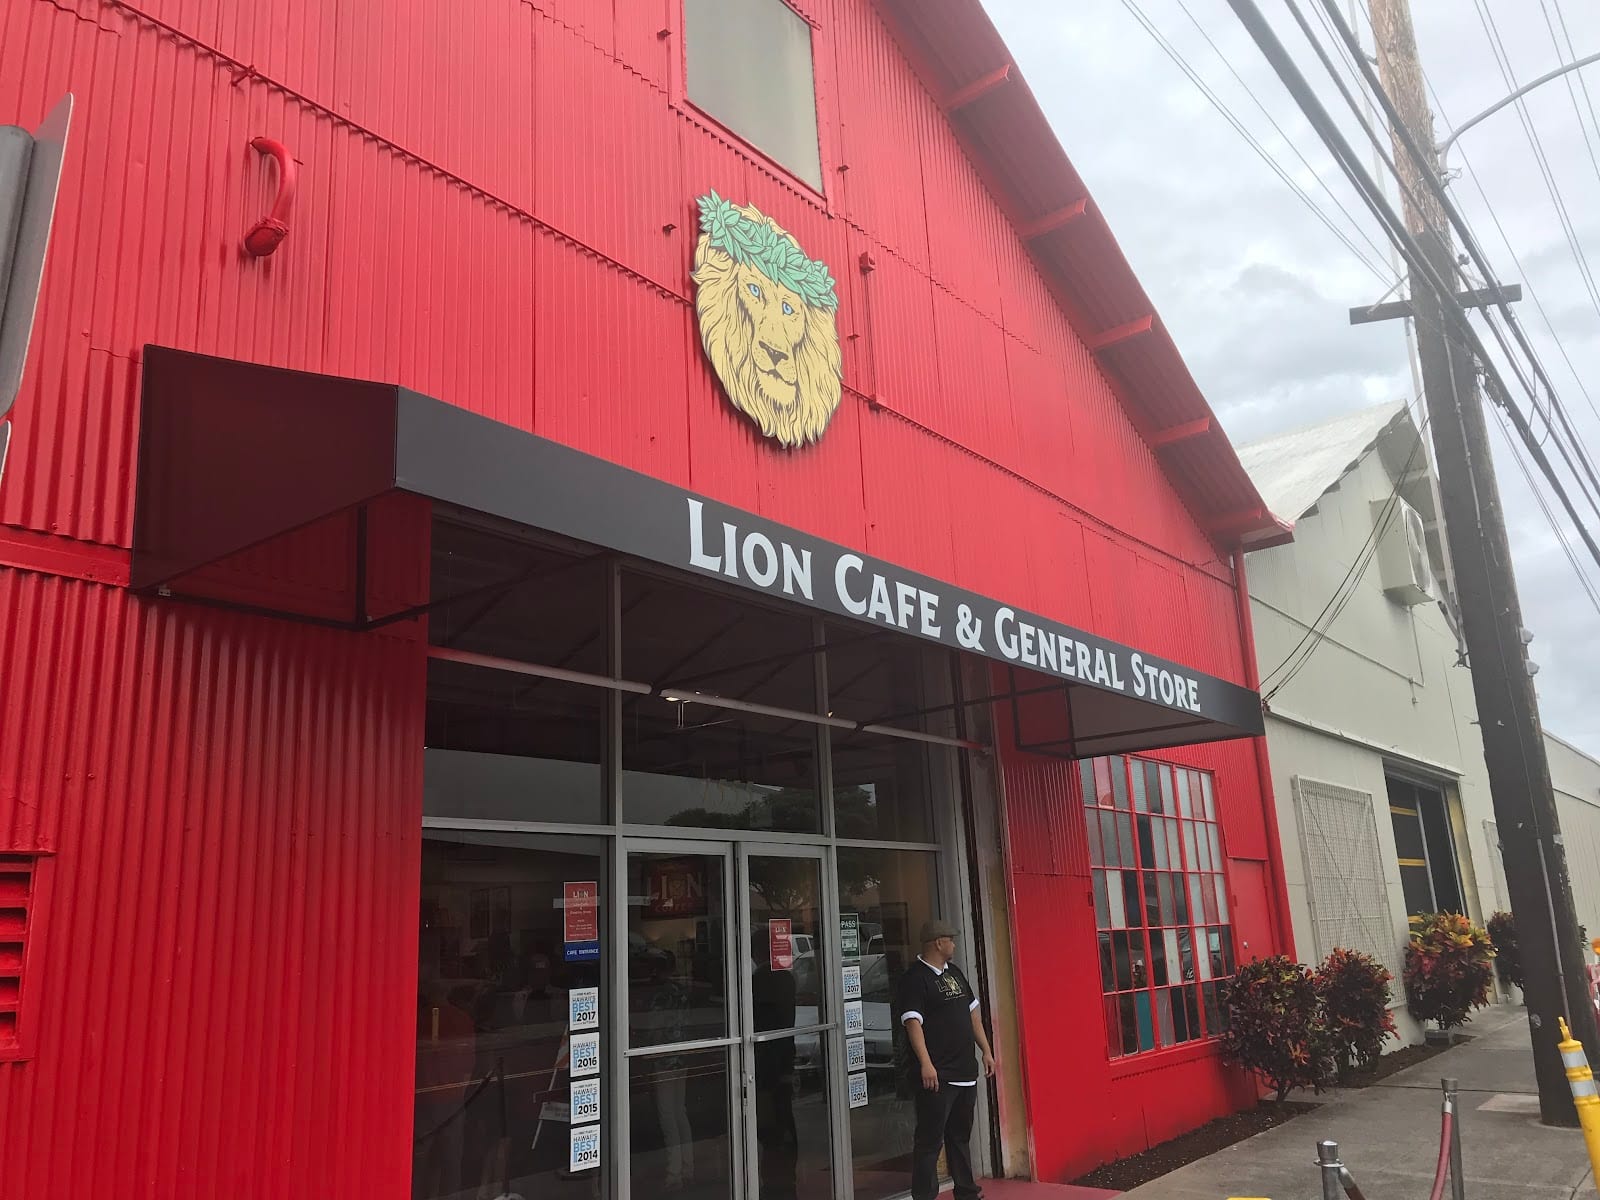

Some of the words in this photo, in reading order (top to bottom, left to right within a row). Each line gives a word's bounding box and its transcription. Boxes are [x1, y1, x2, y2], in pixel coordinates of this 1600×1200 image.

[687, 497, 814, 600] LION
[835, 554, 941, 638] CAFE
[955, 603, 985, 652] &
[994, 607, 1125, 690] GENERAL
[1131, 652, 1201, 713] STORE
[840, 920, 856, 928] PASS
[847, 984, 860, 993] 2017
[572, 1001, 594, 1013] BEST
[576, 1011, 596, 1022] 2017
[573, 1046, 597, 1059] BEST
[577, 1056, 598, 1068] 2016
[573, 1092, 597, 1106] BEST
[853, 1091, 867, 1101] 2014
[577, 1103, 598, 1115] 2015
[573, 1139, 598, 1153] BEST
[577, 1149, 598, 1162] 2014
